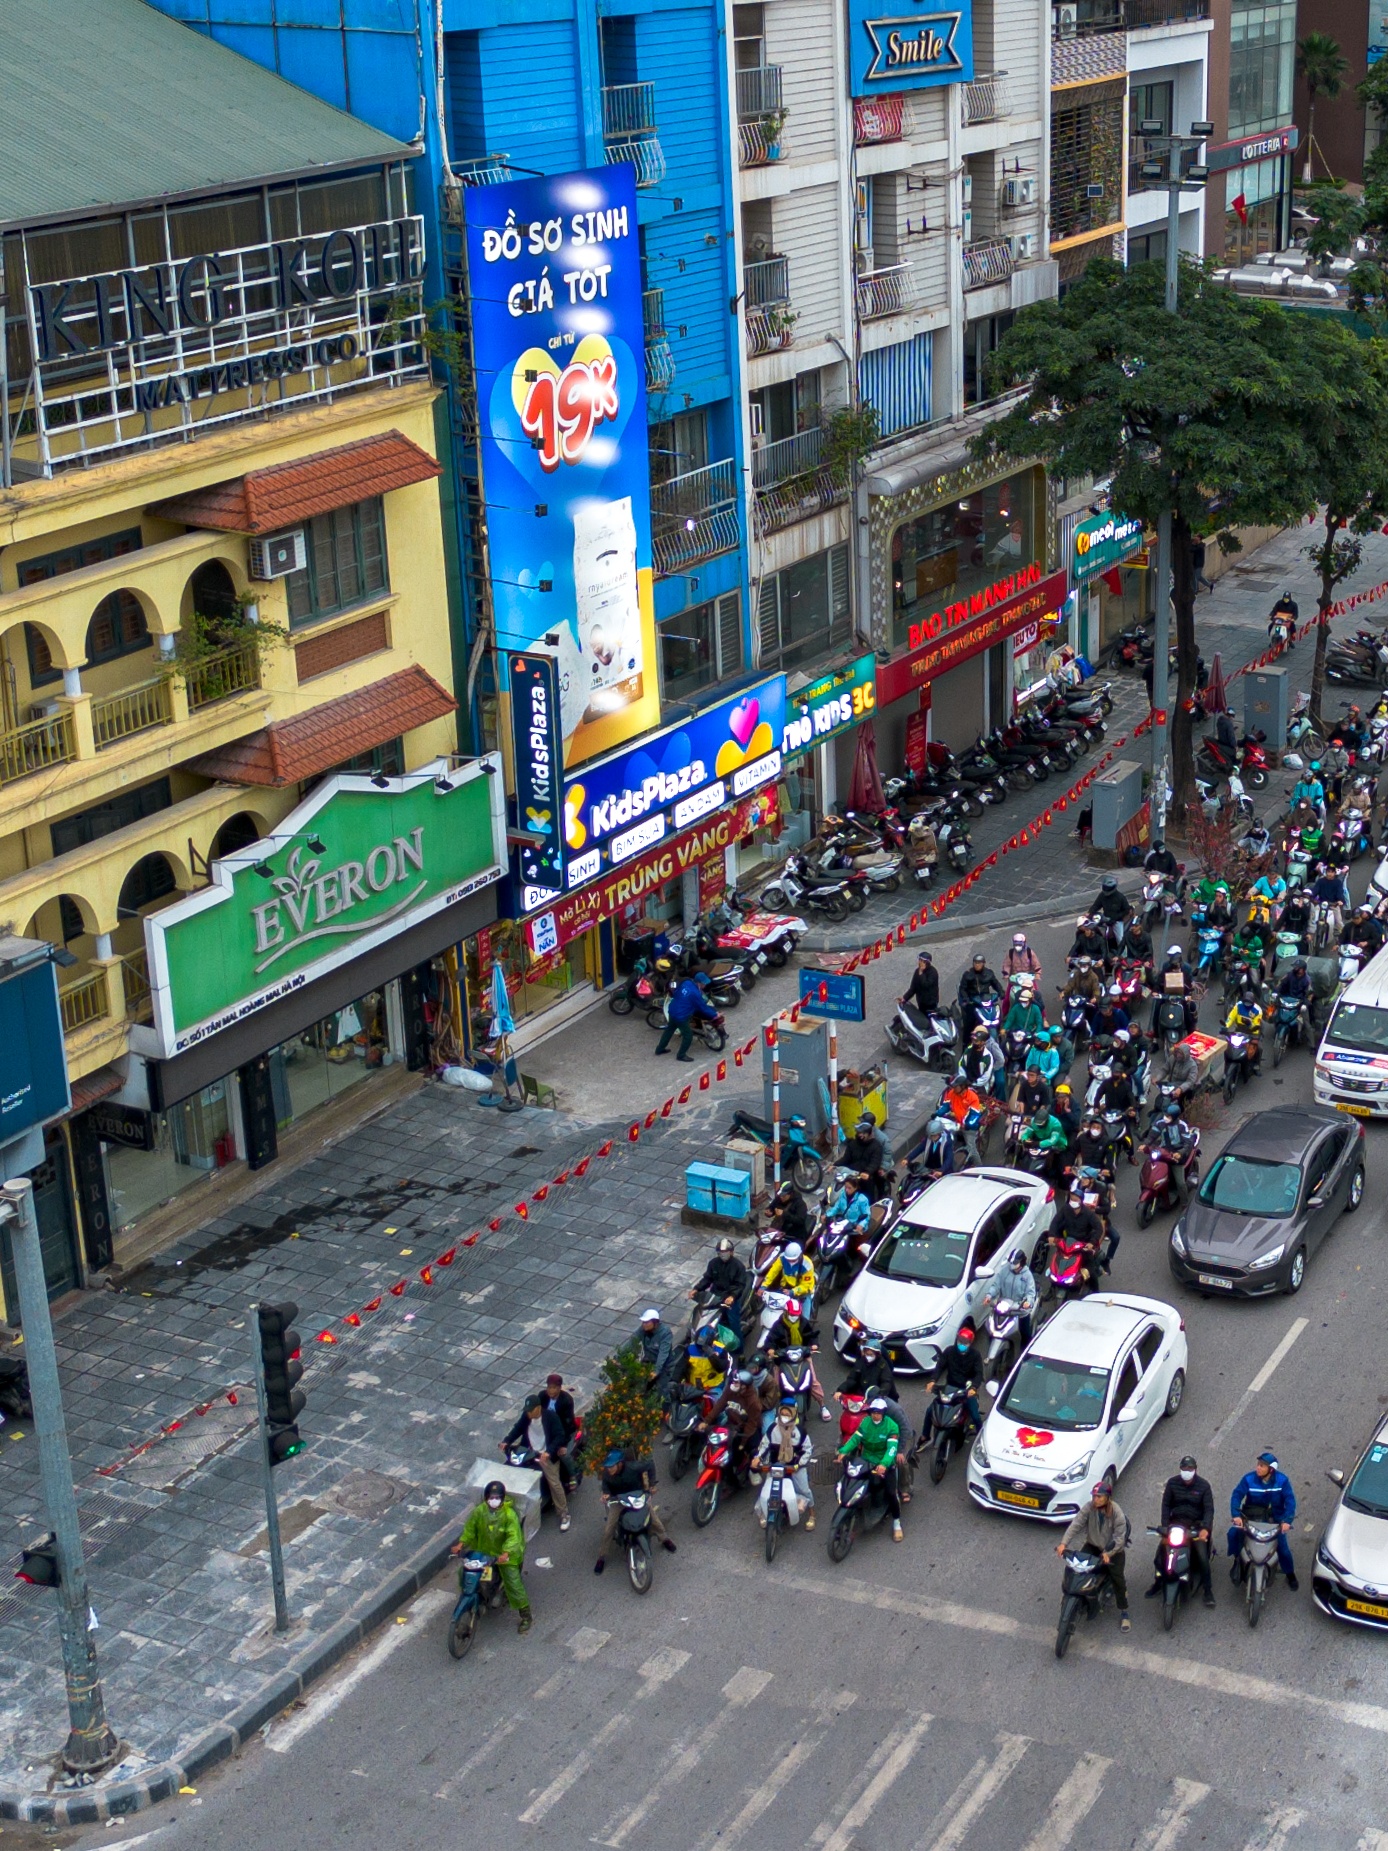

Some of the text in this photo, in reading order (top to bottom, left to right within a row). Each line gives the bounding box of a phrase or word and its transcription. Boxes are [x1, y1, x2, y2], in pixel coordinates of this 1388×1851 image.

[886, 28, 943, 66] Smile
[1242, 137, 1280, 160] LOTTERIA
[528, 217, 562, 255] SƠ
[571, 205, 628, 246] SINH
[34, 221, 429, 361] KING KOIL
[136, 345, 301, 412] MATTRESS
[852, 681, 875, 715] 3C
[530, 685, 551, 803] KidsPlaza
[568, 858, 597, 884] SINH
[738, 756, 778, 788] VITAMIN
[591, 760, 707, 838] KidsPlaza
[251, 826, 426, 954] EVERON
[605, 853, 673, 911] TRÚNG
[676, 818, 730, 869] VÀNG
[87, 1114, 146, 1141] EVERON
